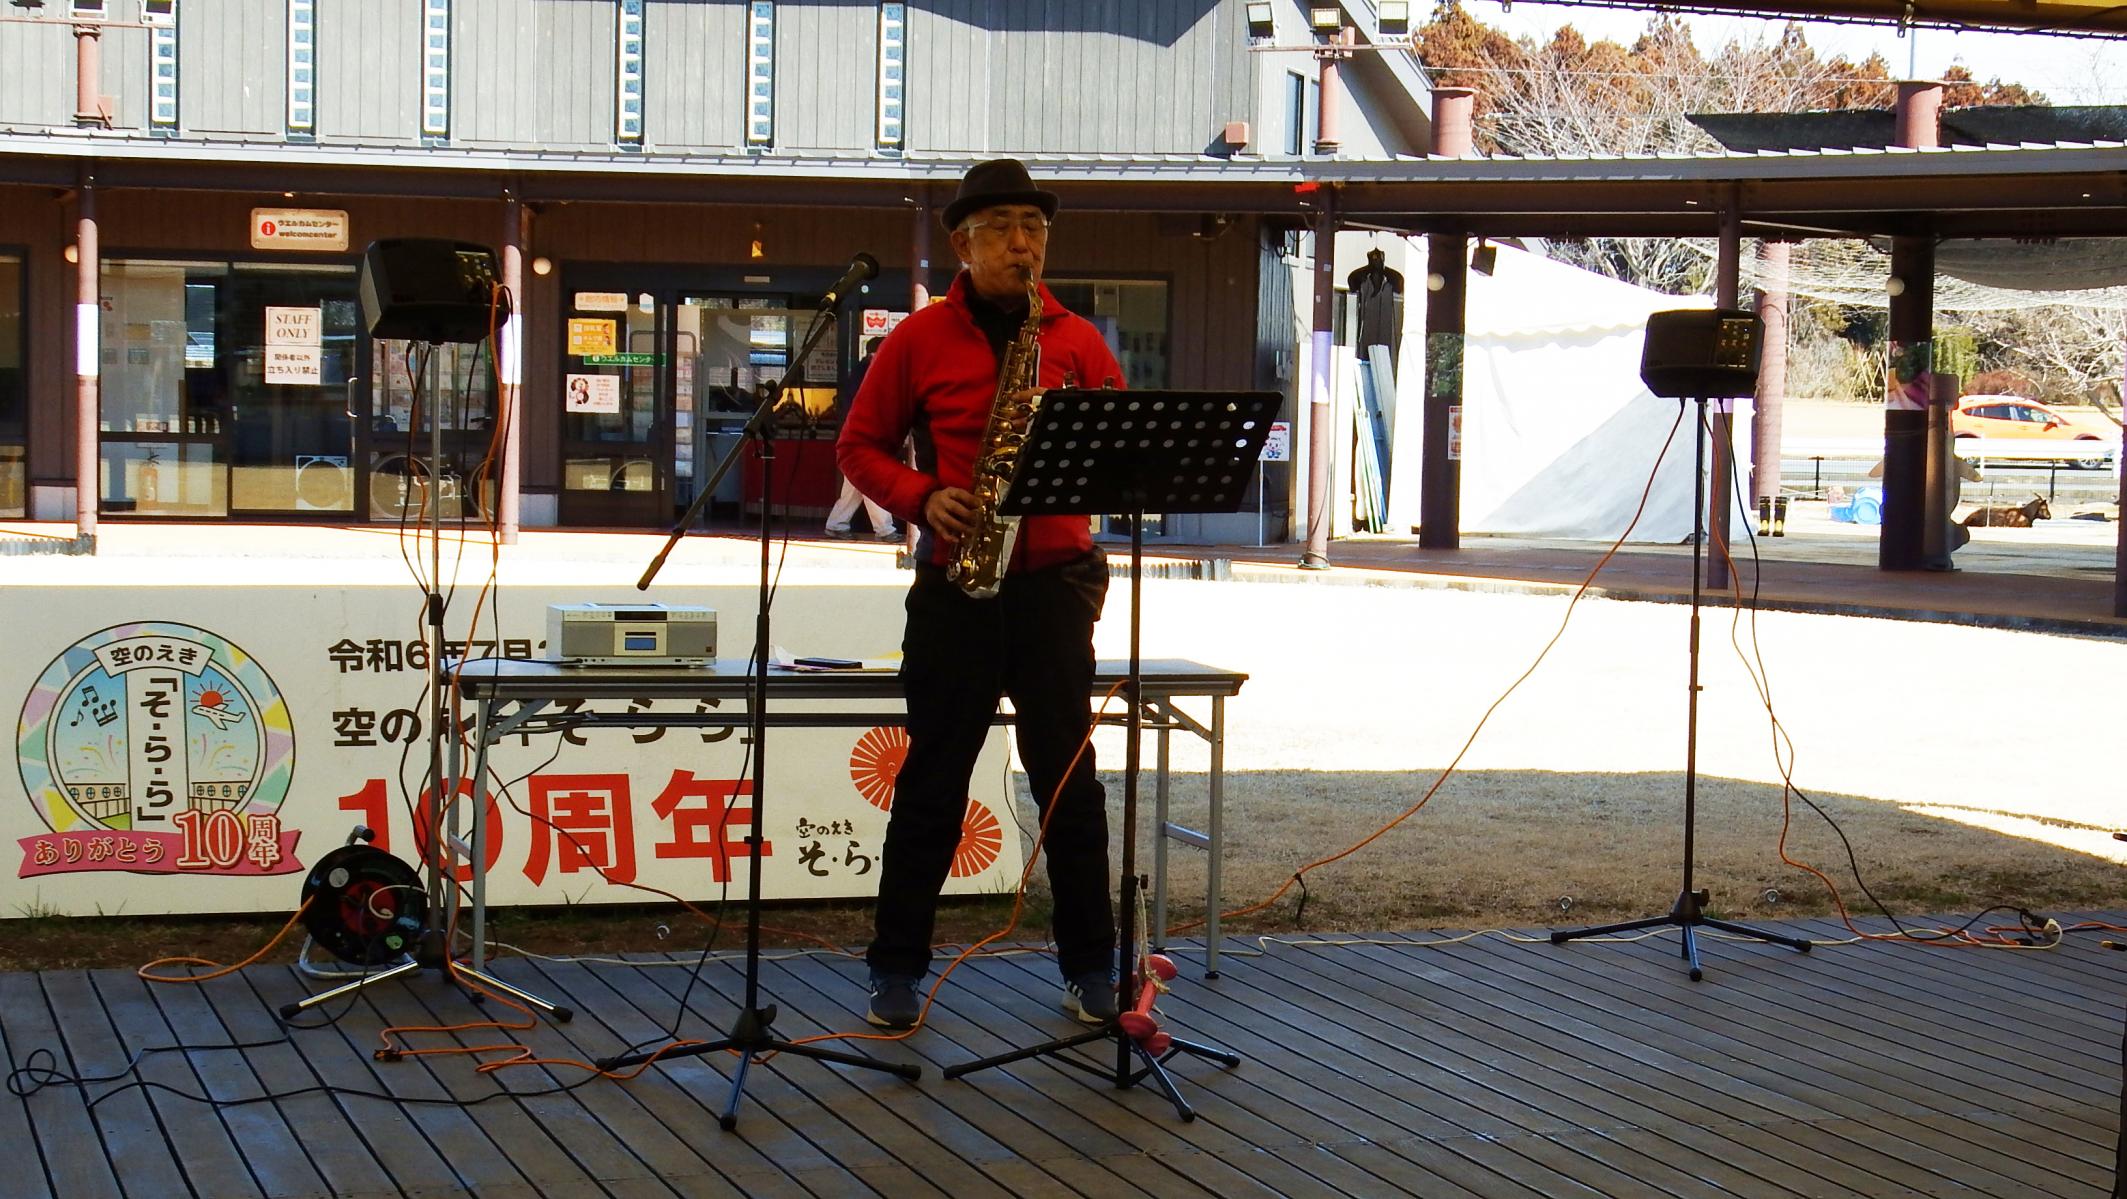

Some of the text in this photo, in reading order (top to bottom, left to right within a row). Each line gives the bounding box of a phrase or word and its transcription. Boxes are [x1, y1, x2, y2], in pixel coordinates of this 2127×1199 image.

[275, 313, 313, 325] STAFF
[276, 327, 311, 339] ONLY
[600, 355, 655, 364] ウエルカムセンタ
[267, 366, 319, 375] 立ち入り禁止
[109, 644, 199, 668] 空のえき
[338, 768, 774, 888] 10周年
[795, 817, 854, 839] 空のえき
[34, 836, 167, 866] ありがとう
